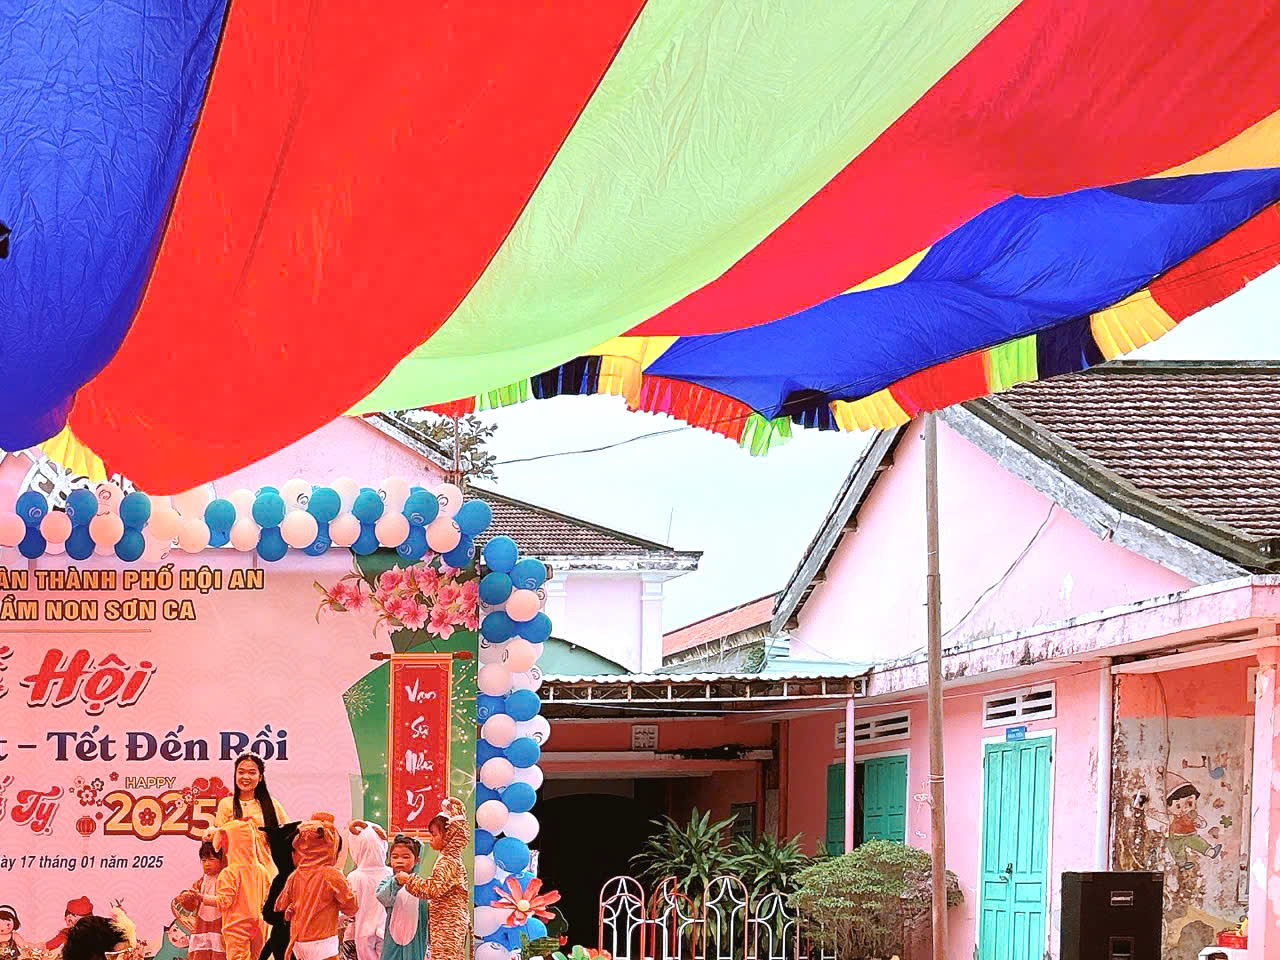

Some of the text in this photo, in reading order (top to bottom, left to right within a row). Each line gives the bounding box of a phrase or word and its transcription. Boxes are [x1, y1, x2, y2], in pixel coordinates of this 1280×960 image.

[35, 566, 117, 591] THÀNH
[123, 563, 175, 591] PHỐ
[179, 565, 223, 594] HỘI
[228, 569, 264, 590] AN
[45, 600, 98, 620] NON
[104, 598, 156, 620] SƠN
[162, 600, 196, 620] CA
[20, 648, 156, 714] Hội
[46, 724, 117, 761] Tết
[125, 724, 209, 761] Đến
[219, 724, 289, 761] Rồi
[125, 776, 176, 789] HAPPY
[11, 785, 64, 836] Tỵ
[104, 790, 219, 841] 2025
[20, 855, 36, 868] 17
[39, 854, 76, 871] tháng
[80, 855, 95, 868] 01
[100, 854, 128, 868] năm
[132, 855, 164, 868] 2025
